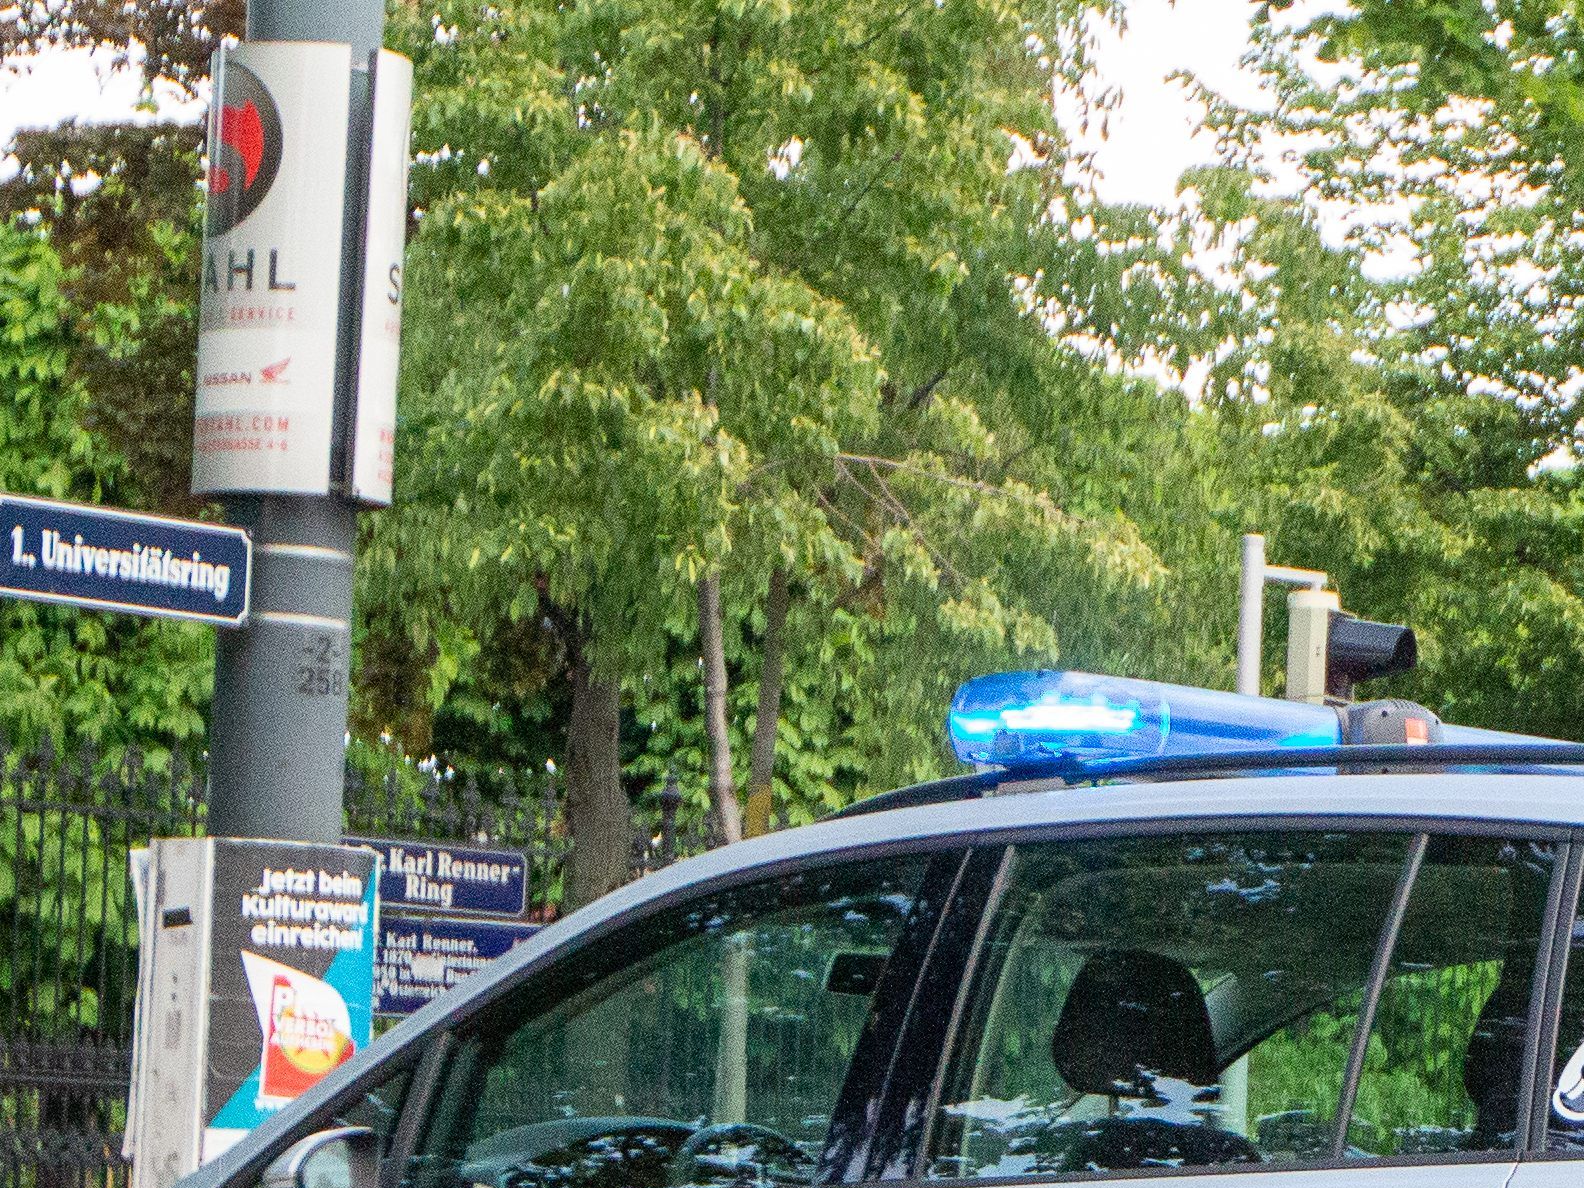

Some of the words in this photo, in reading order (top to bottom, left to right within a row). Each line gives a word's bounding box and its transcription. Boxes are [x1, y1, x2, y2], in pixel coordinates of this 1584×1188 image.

[41, 527, 231, 601] Universitätsring
[389, 847, 433, 876] Karl
[319, 870, 363, 897] beim
[404, 875, 454, 908] Ring
